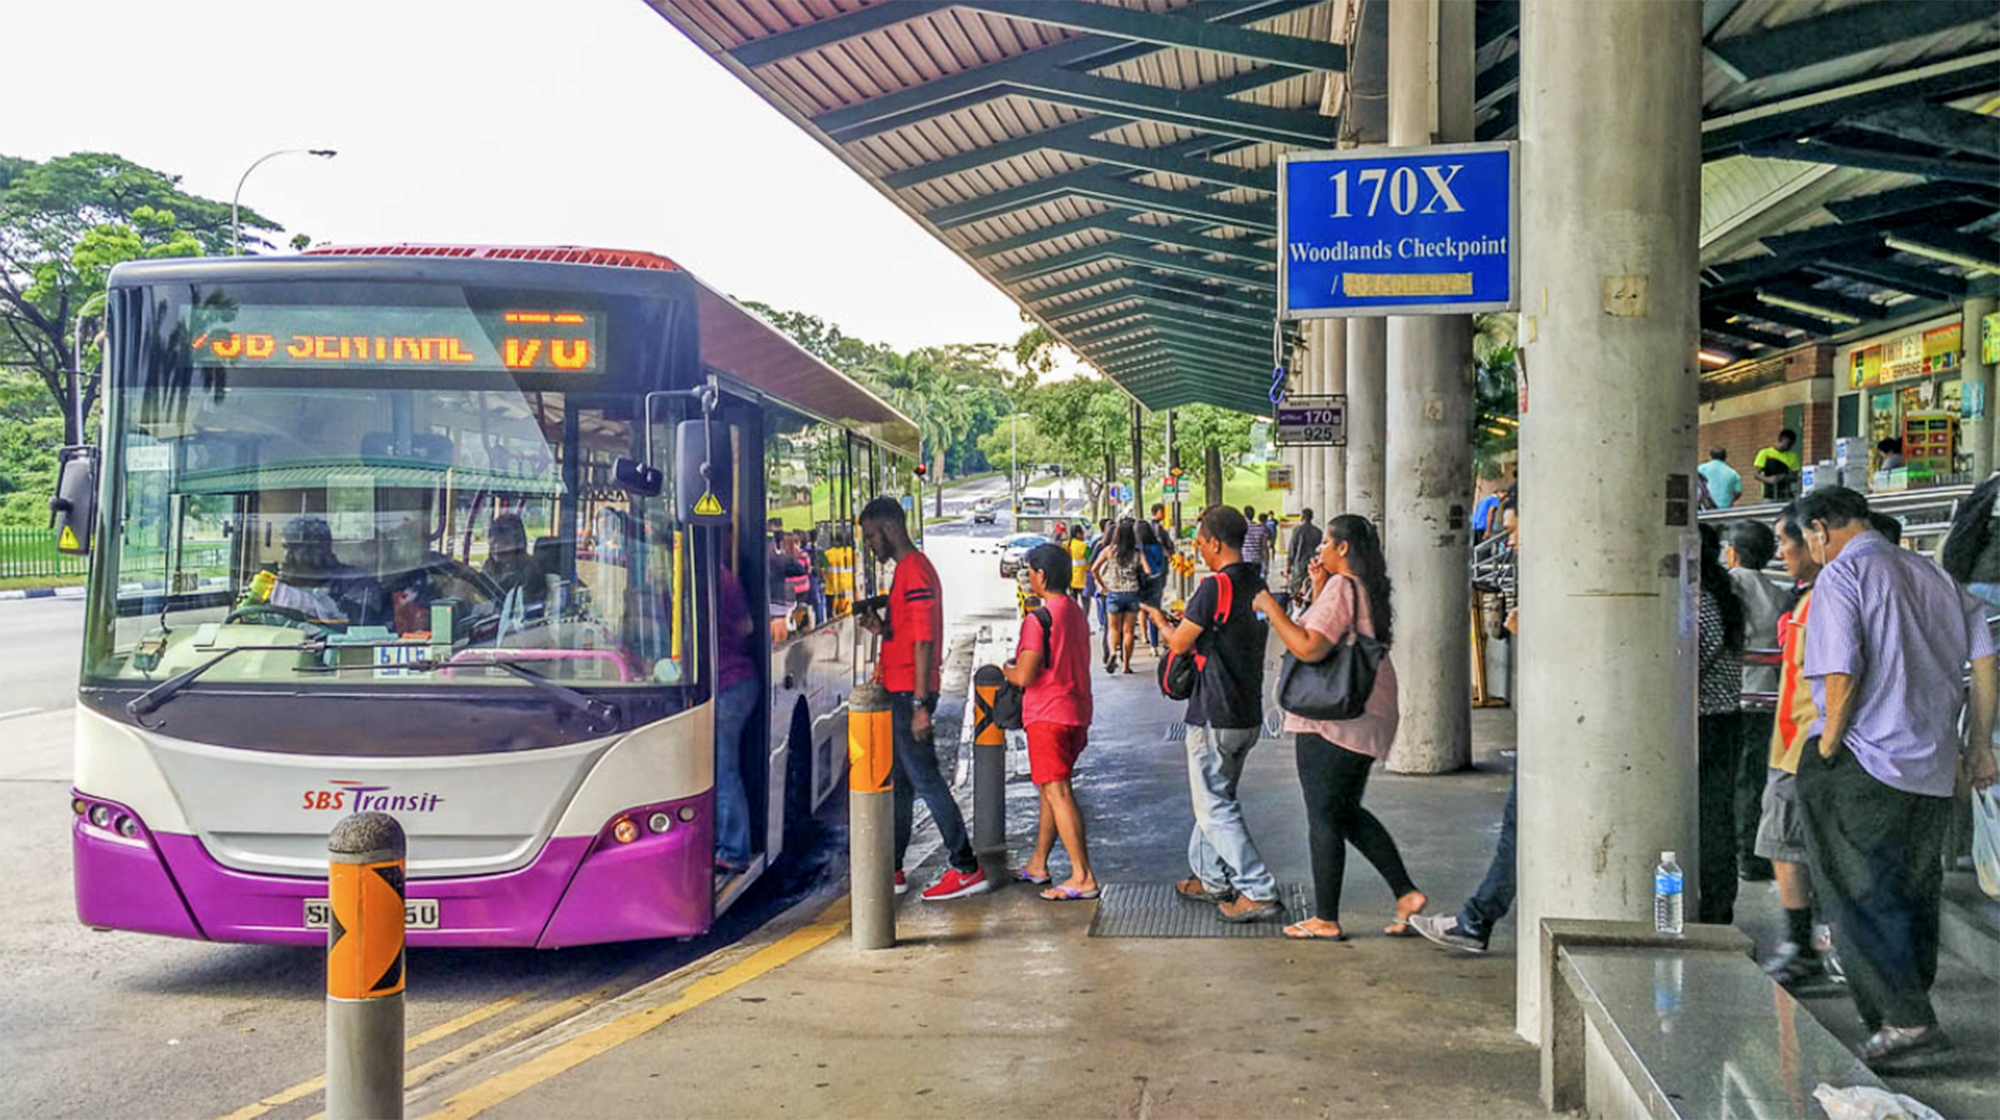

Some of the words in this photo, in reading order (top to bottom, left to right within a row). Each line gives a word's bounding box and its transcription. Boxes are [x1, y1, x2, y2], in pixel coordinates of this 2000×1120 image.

[1328, 164, 1466, 218] 170X
[1289, 239, 1393, 263] Woodlands
[1398, 234, 1507, 262] Checkpoint
[1304, 410, 1333, 424] 170
[1303, 427, 1332, 441] 925
[302, 790, 346, 811] SBS
[342, 786, 446, 814] Transit
